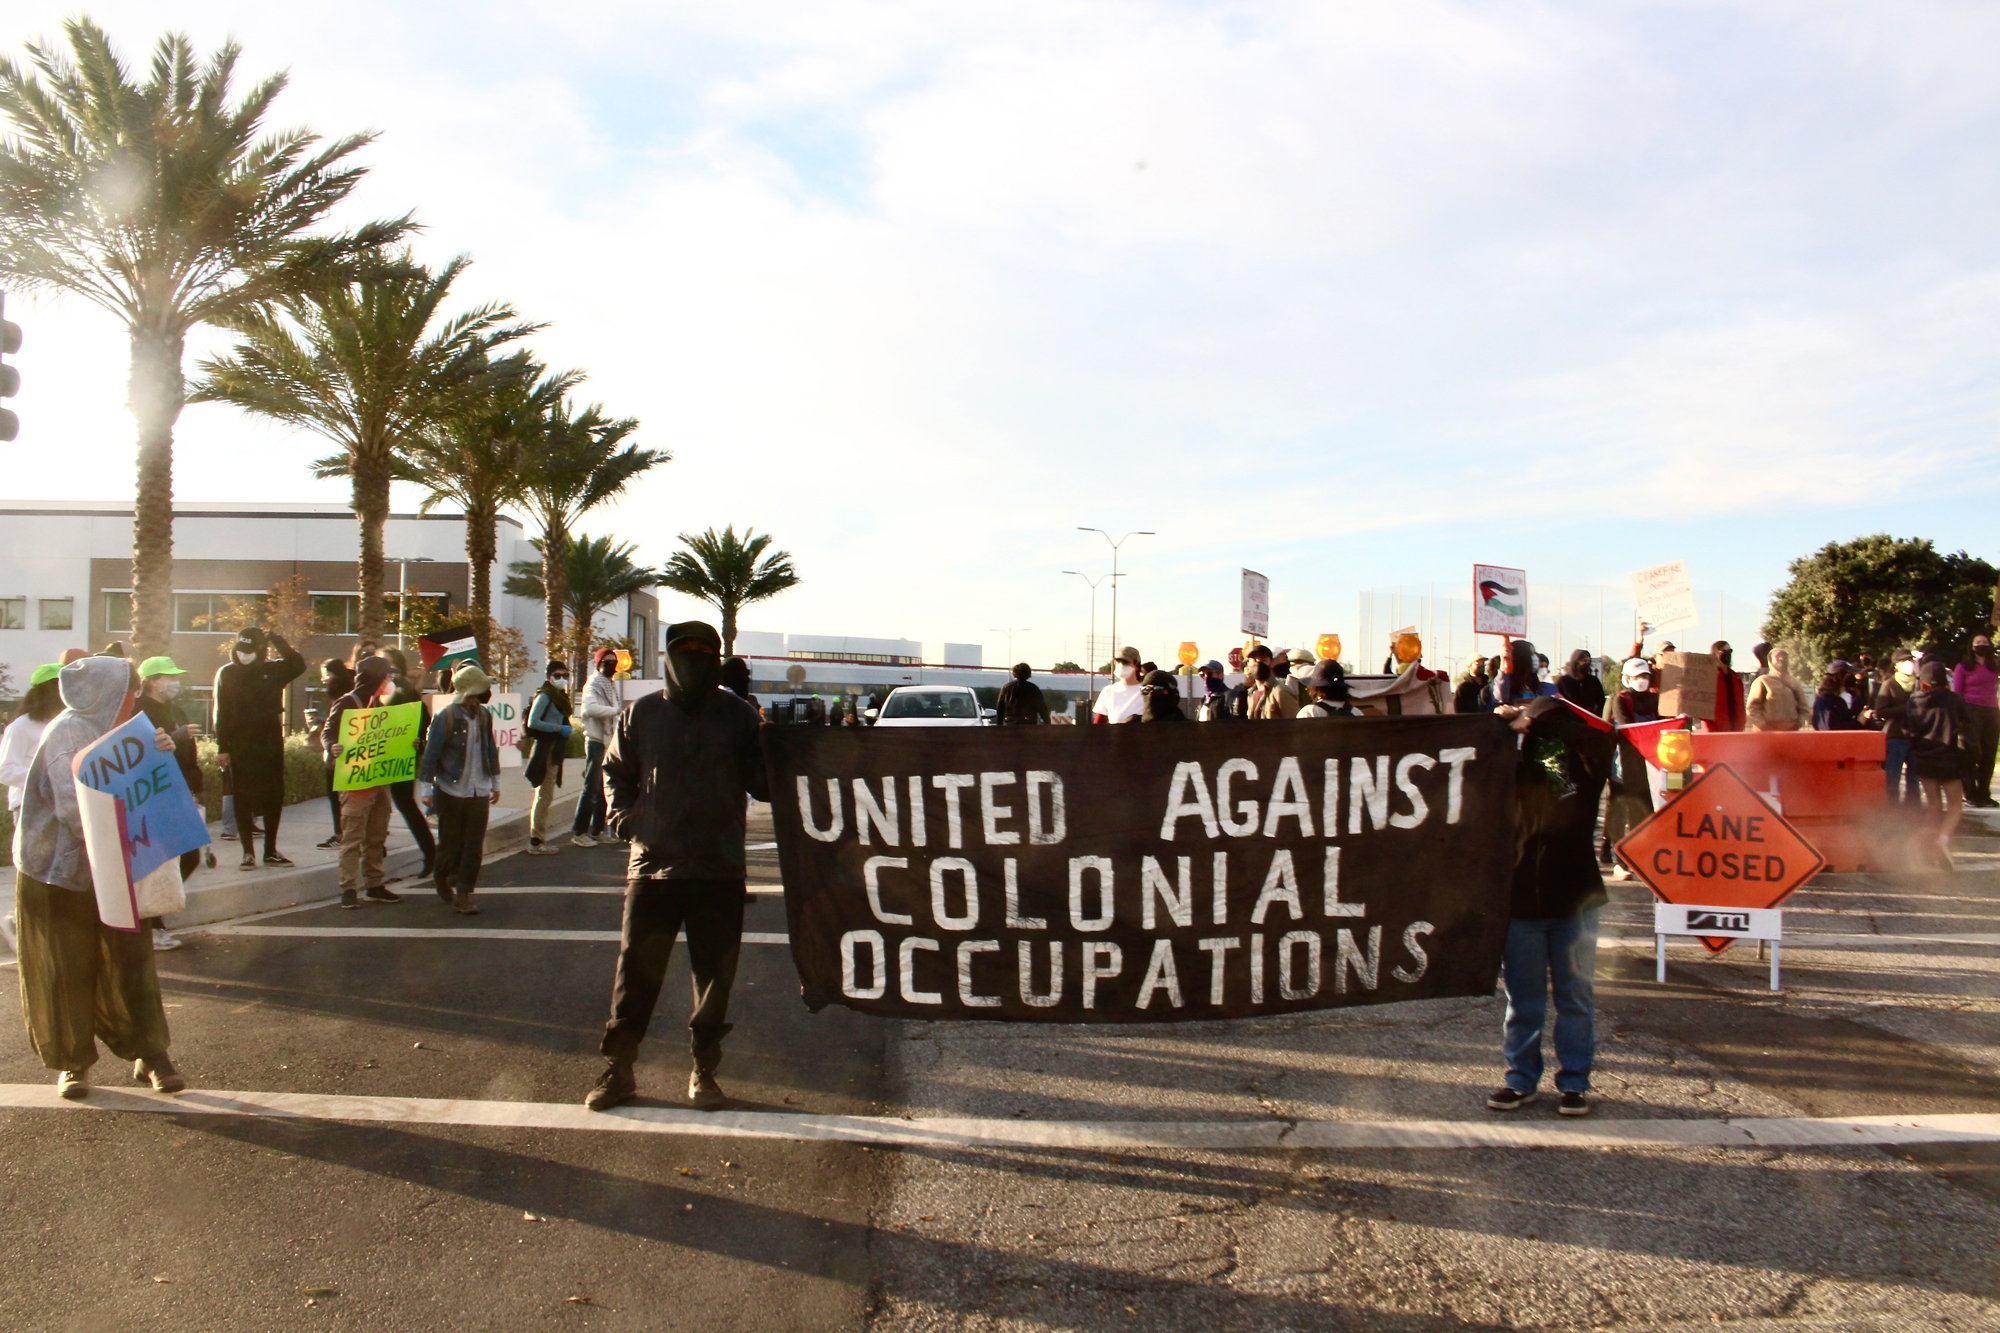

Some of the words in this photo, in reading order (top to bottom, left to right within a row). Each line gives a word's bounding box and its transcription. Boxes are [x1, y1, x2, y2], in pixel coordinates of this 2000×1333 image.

[1637, 563, 1681, 583] CEASEFIRE
[1229, 653, 1243, 662] STO
[348, 711, 389, 737] STOP
[487, 703, 515, 721] ND
[356, 724, 411, 745] GENOCIDE
[493, 728, 518, 747] IDE
[80, 737, 145, 790] UND
[345, 740, 387, 764] FREE
[347, 757, 416, 784] PALESTINE
[113, 762, 172, 813] IDE
[797, 770, 1066, 849] UNITED
[1160, 747, 1476, 841] AGAINST
[1677, 812, 1765, 842] LANE
[1653, 848, 1785, 882] CLOSED
[863, 846, 1366, 931] COLONIAL
[840, 921, 1435, 1009] OCCUPATIONS
